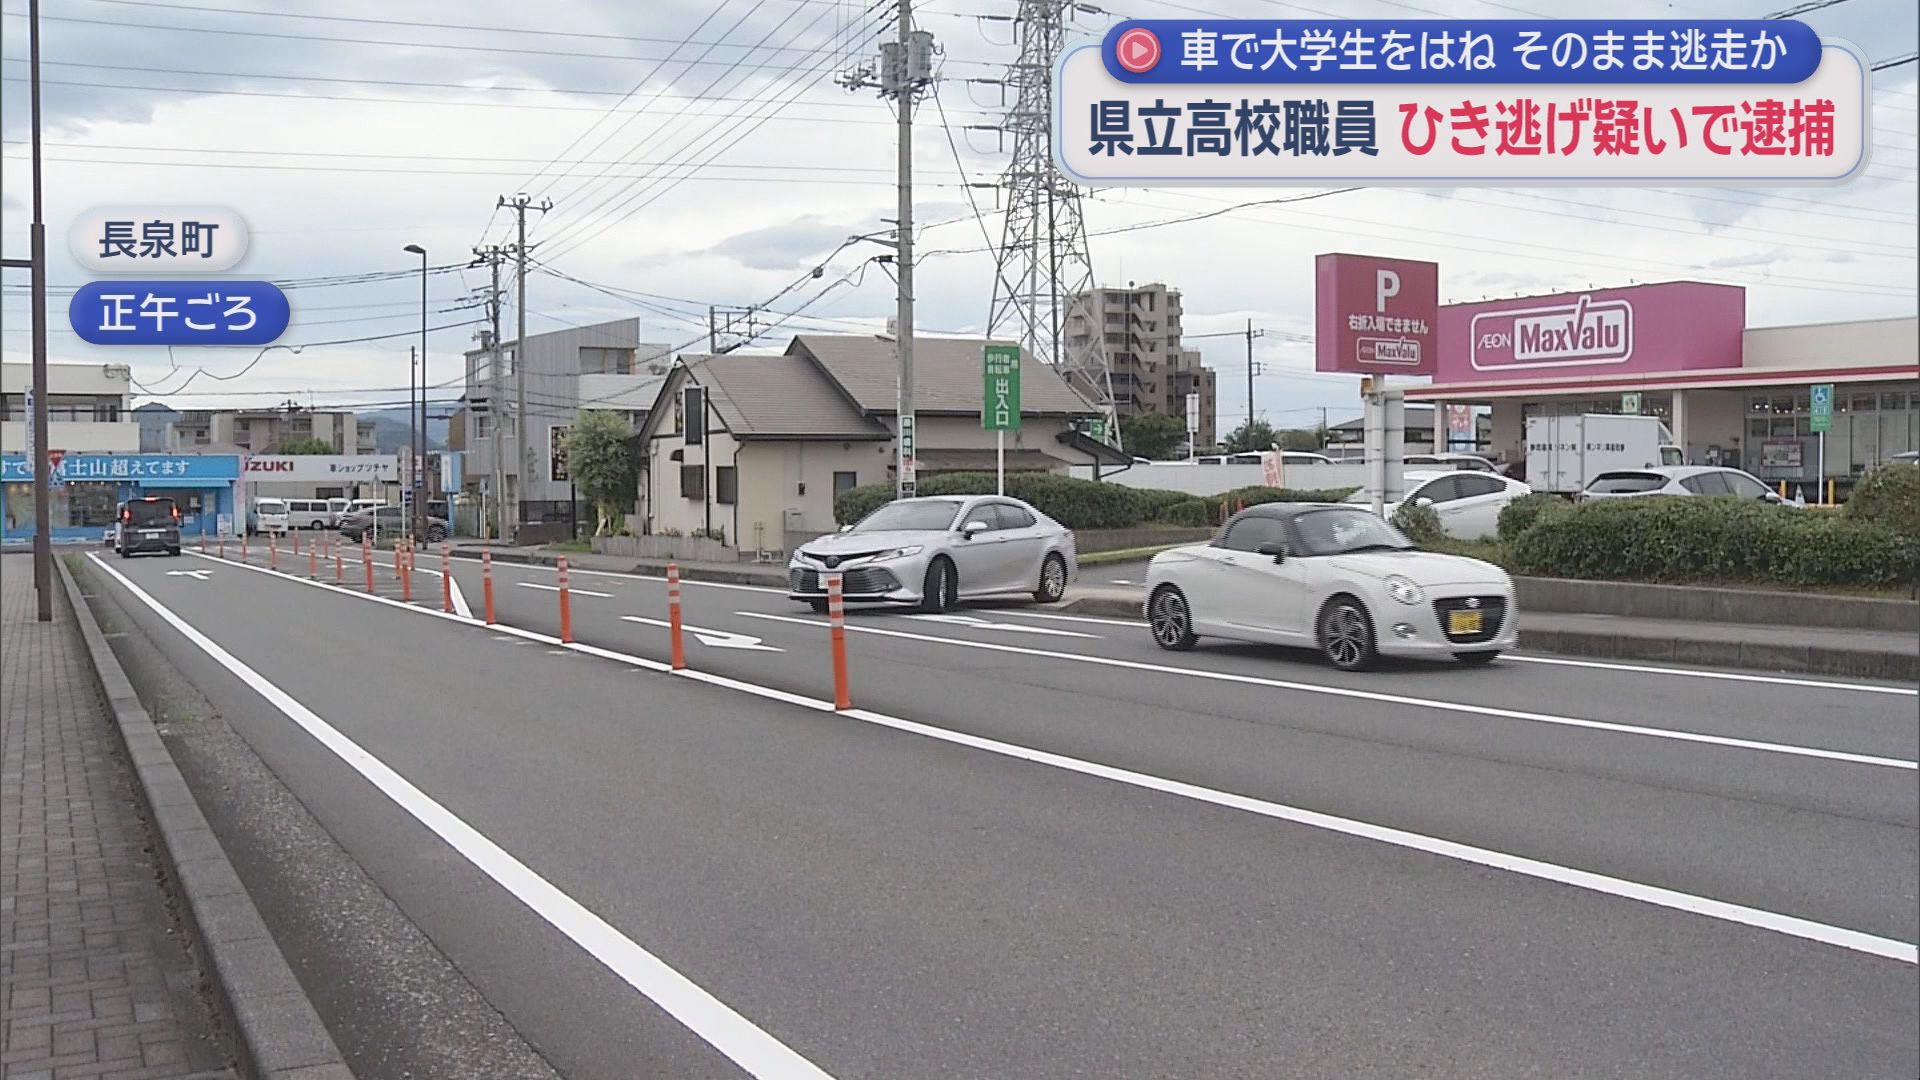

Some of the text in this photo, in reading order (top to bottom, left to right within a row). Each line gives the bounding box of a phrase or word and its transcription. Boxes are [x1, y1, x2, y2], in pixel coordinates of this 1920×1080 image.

[1377, 269, 1400, 312] P
[1520, 298, 1619, 353] MaxValu
[995, 378, 1009, 426] 出入口
